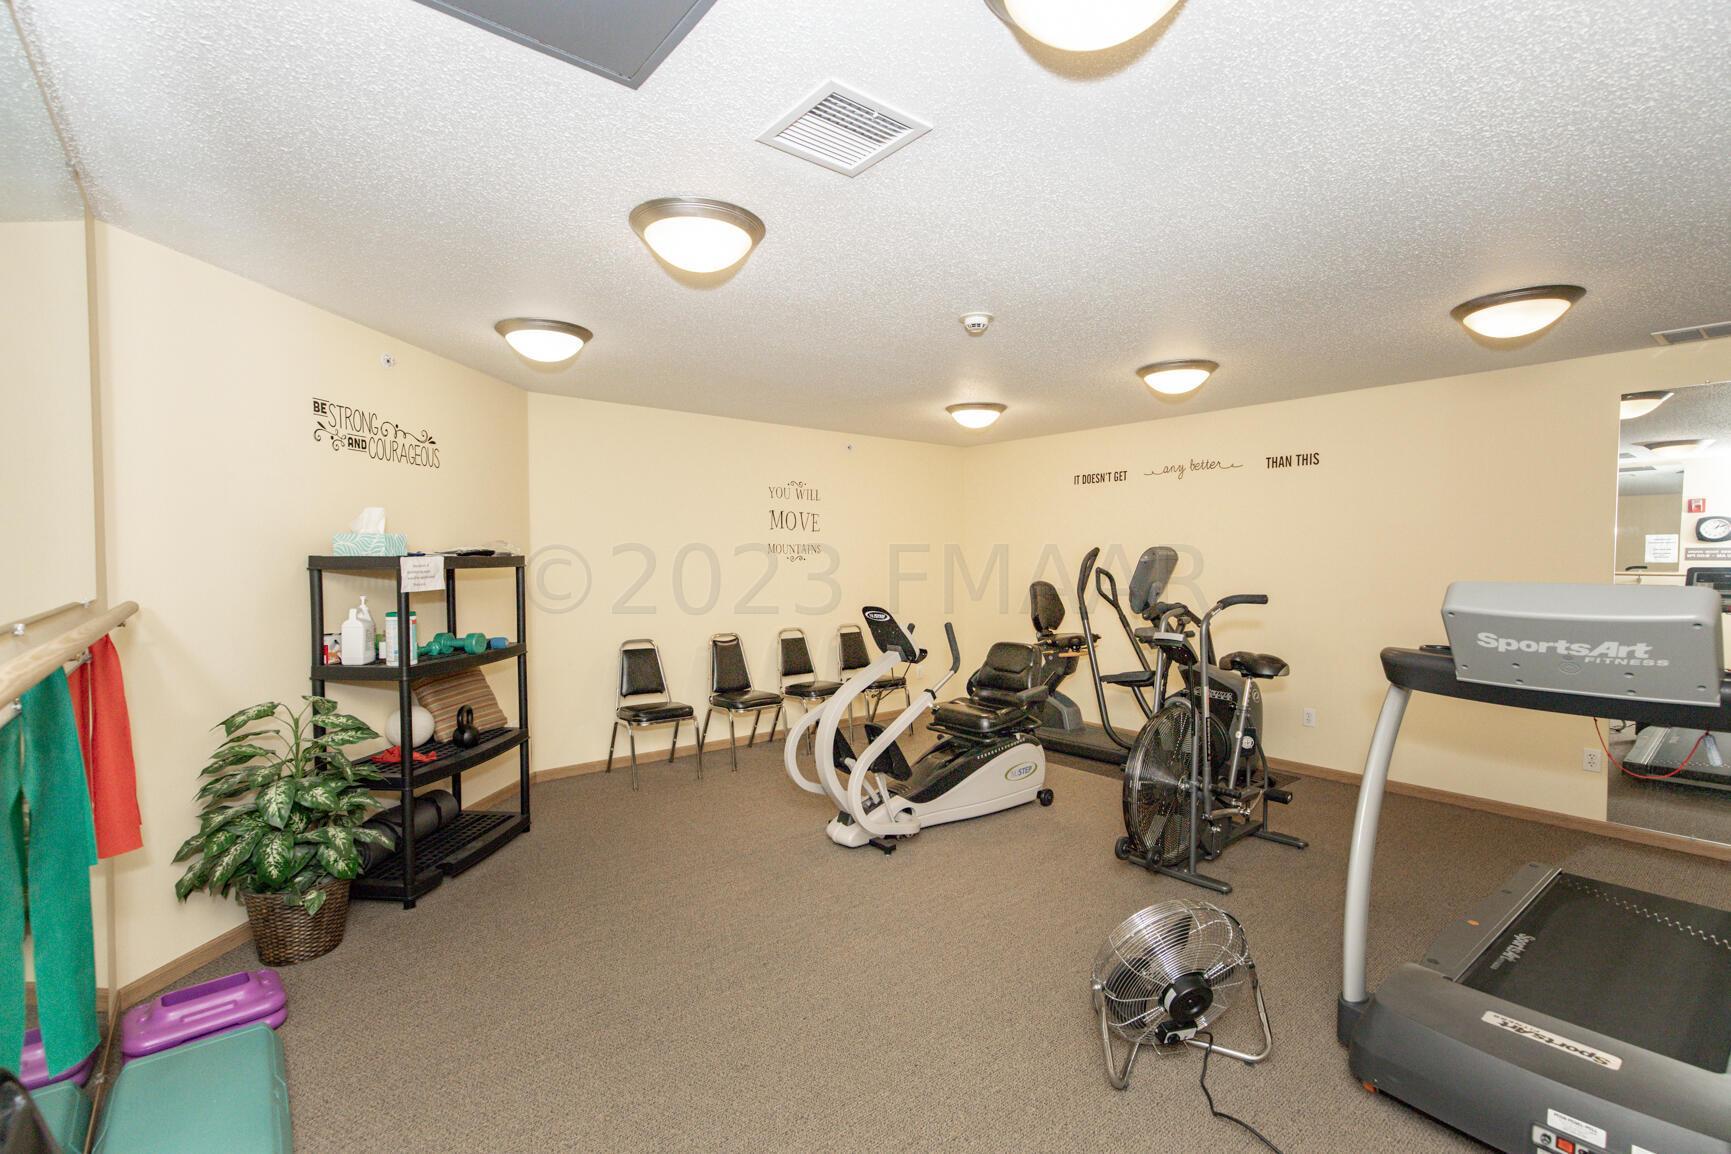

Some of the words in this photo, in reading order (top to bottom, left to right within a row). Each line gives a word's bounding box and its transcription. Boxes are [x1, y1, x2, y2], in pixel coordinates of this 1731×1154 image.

[313, 400, 327, 414] BE
[328, 403, 378, 435] STRONG
[347, 436, 367, 450] AND
[368, 436, 440, 468] COURAGEOUS
[1073, 475, 1080, 485] IT
[1082, 472, 1112, 484] DOESN'T
[1114, 470, 1128, 482] GET
[1152, 464, 1186, 480] any
[1189, 458, 1234, 471] better
[1266, 455, 1292, 469] THAN
[1296, 452, 1320, 467] THIS
[768, 486, 791, 499] YOU
[795, 488, 821, 501] WILL
[768, 509, 821, 532] MOVE
[767, 543, 822, 555] MOUNTAINS
[1476, 632, 1653, 658] SportsArt
[1584, 657, 1670, 667] FITNESS
[1499, 1020, 1610, 1065] SportsArt
